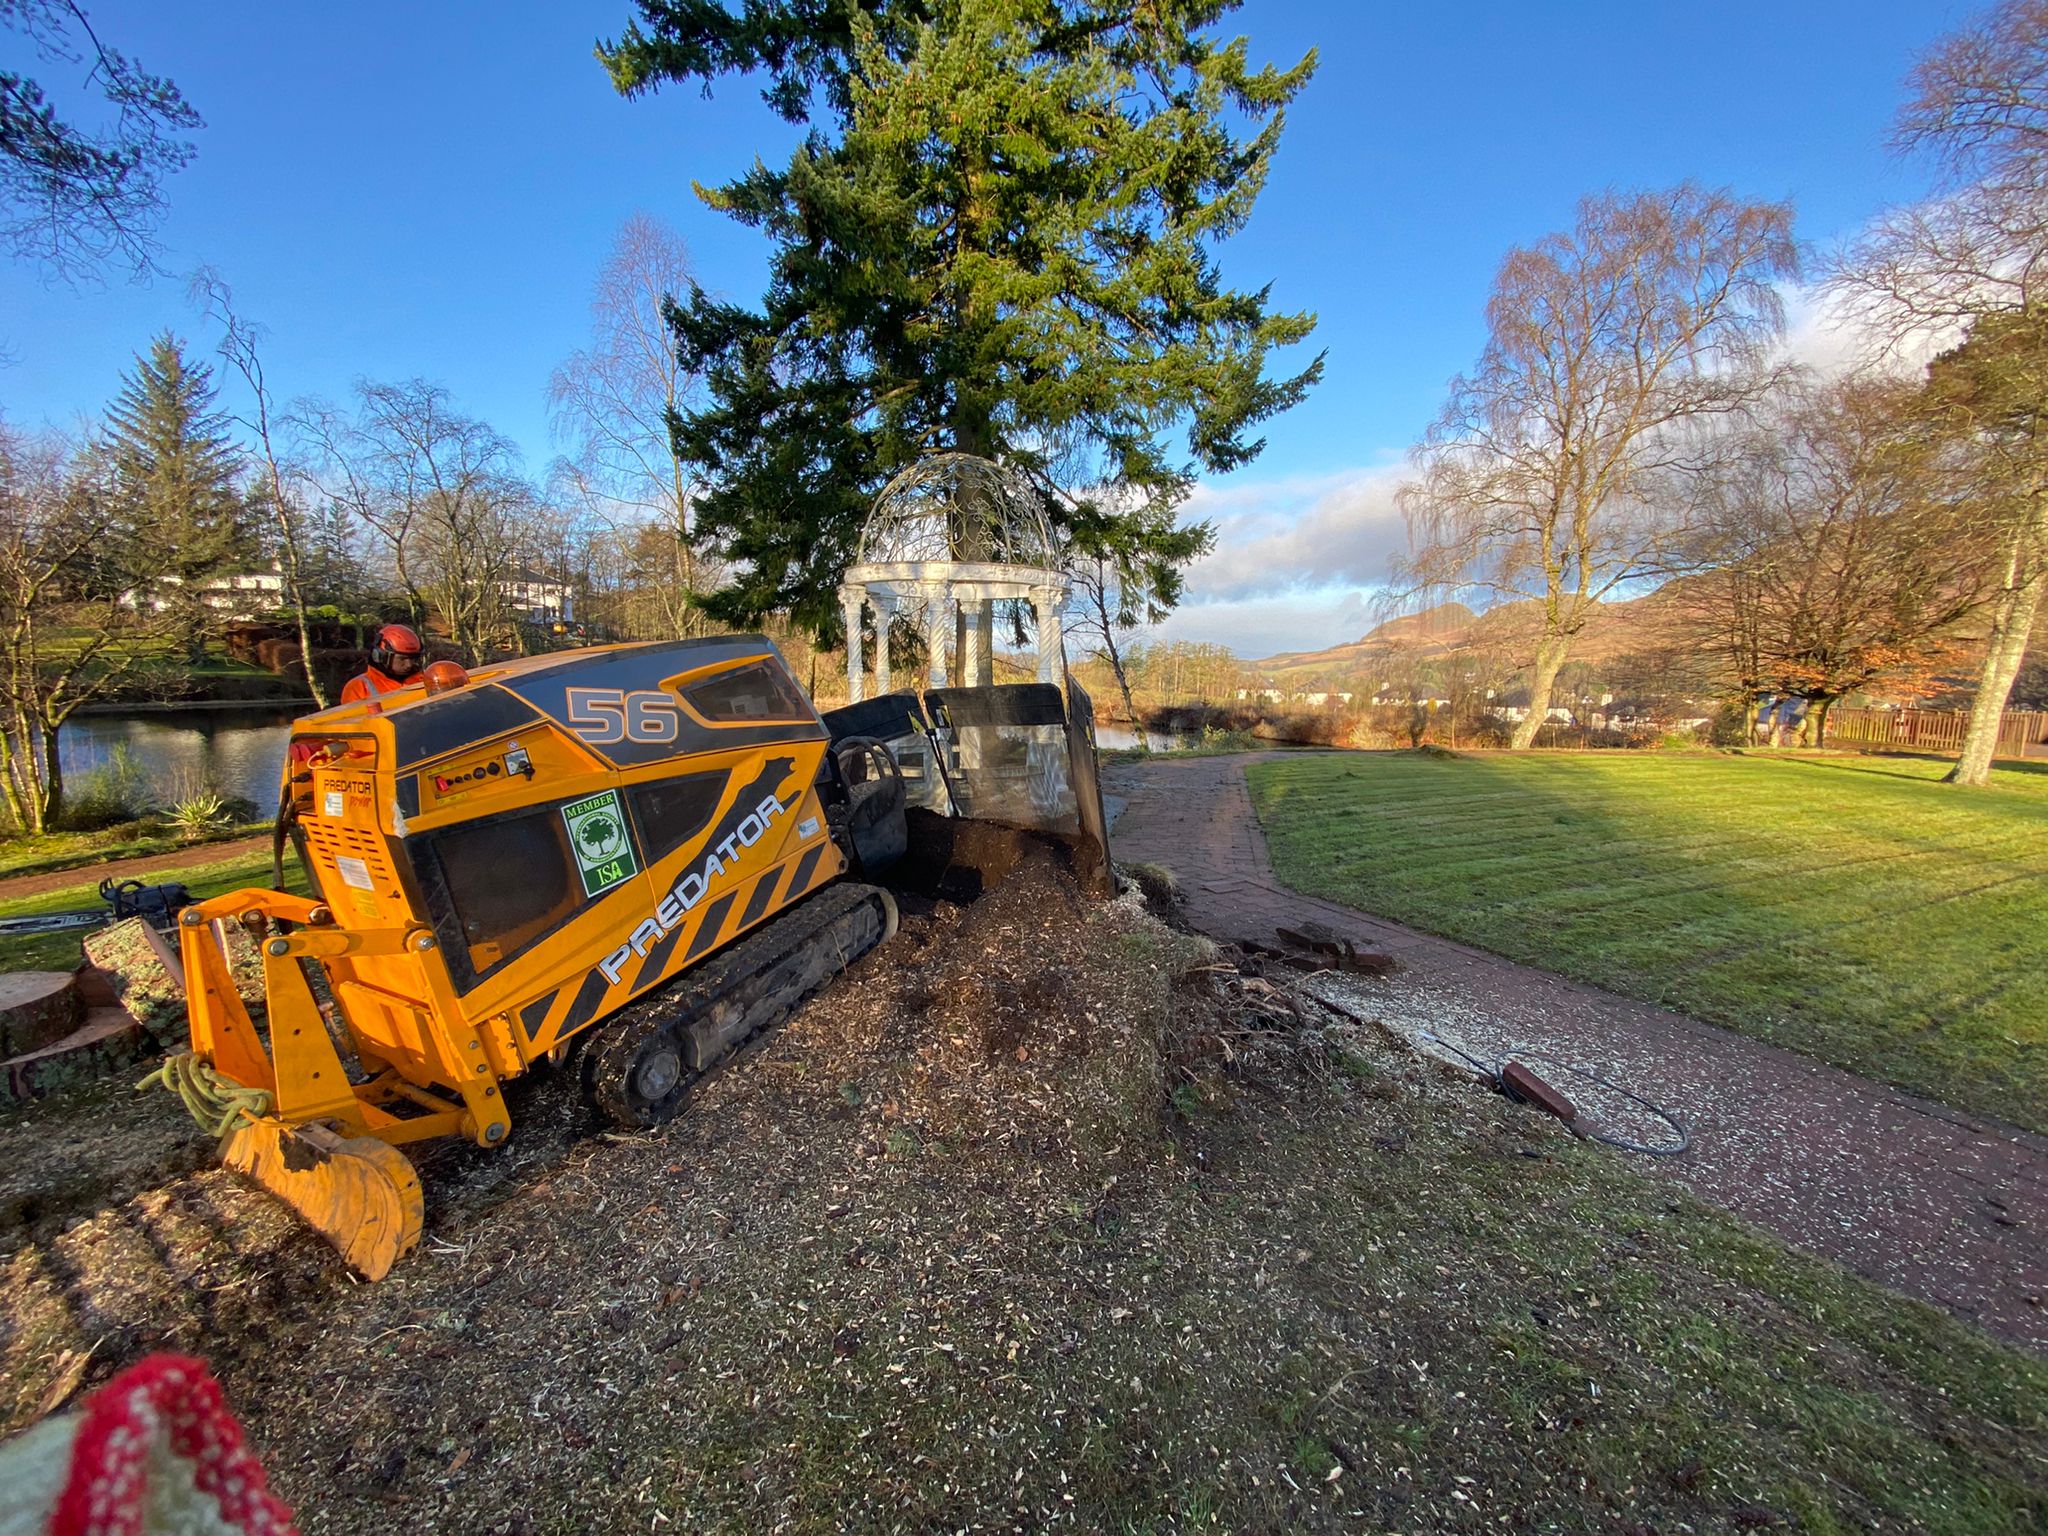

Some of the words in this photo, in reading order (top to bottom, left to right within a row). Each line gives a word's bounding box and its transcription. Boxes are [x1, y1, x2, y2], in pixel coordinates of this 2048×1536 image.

[566, 687, 678, 744] 56
[324, 779, 371, 794] PREDATOR
[566, 794, 613, 818] MEMBER
[597, 861, 623, 886] ISA
[598, 794, 785, 985] PREDATOR
